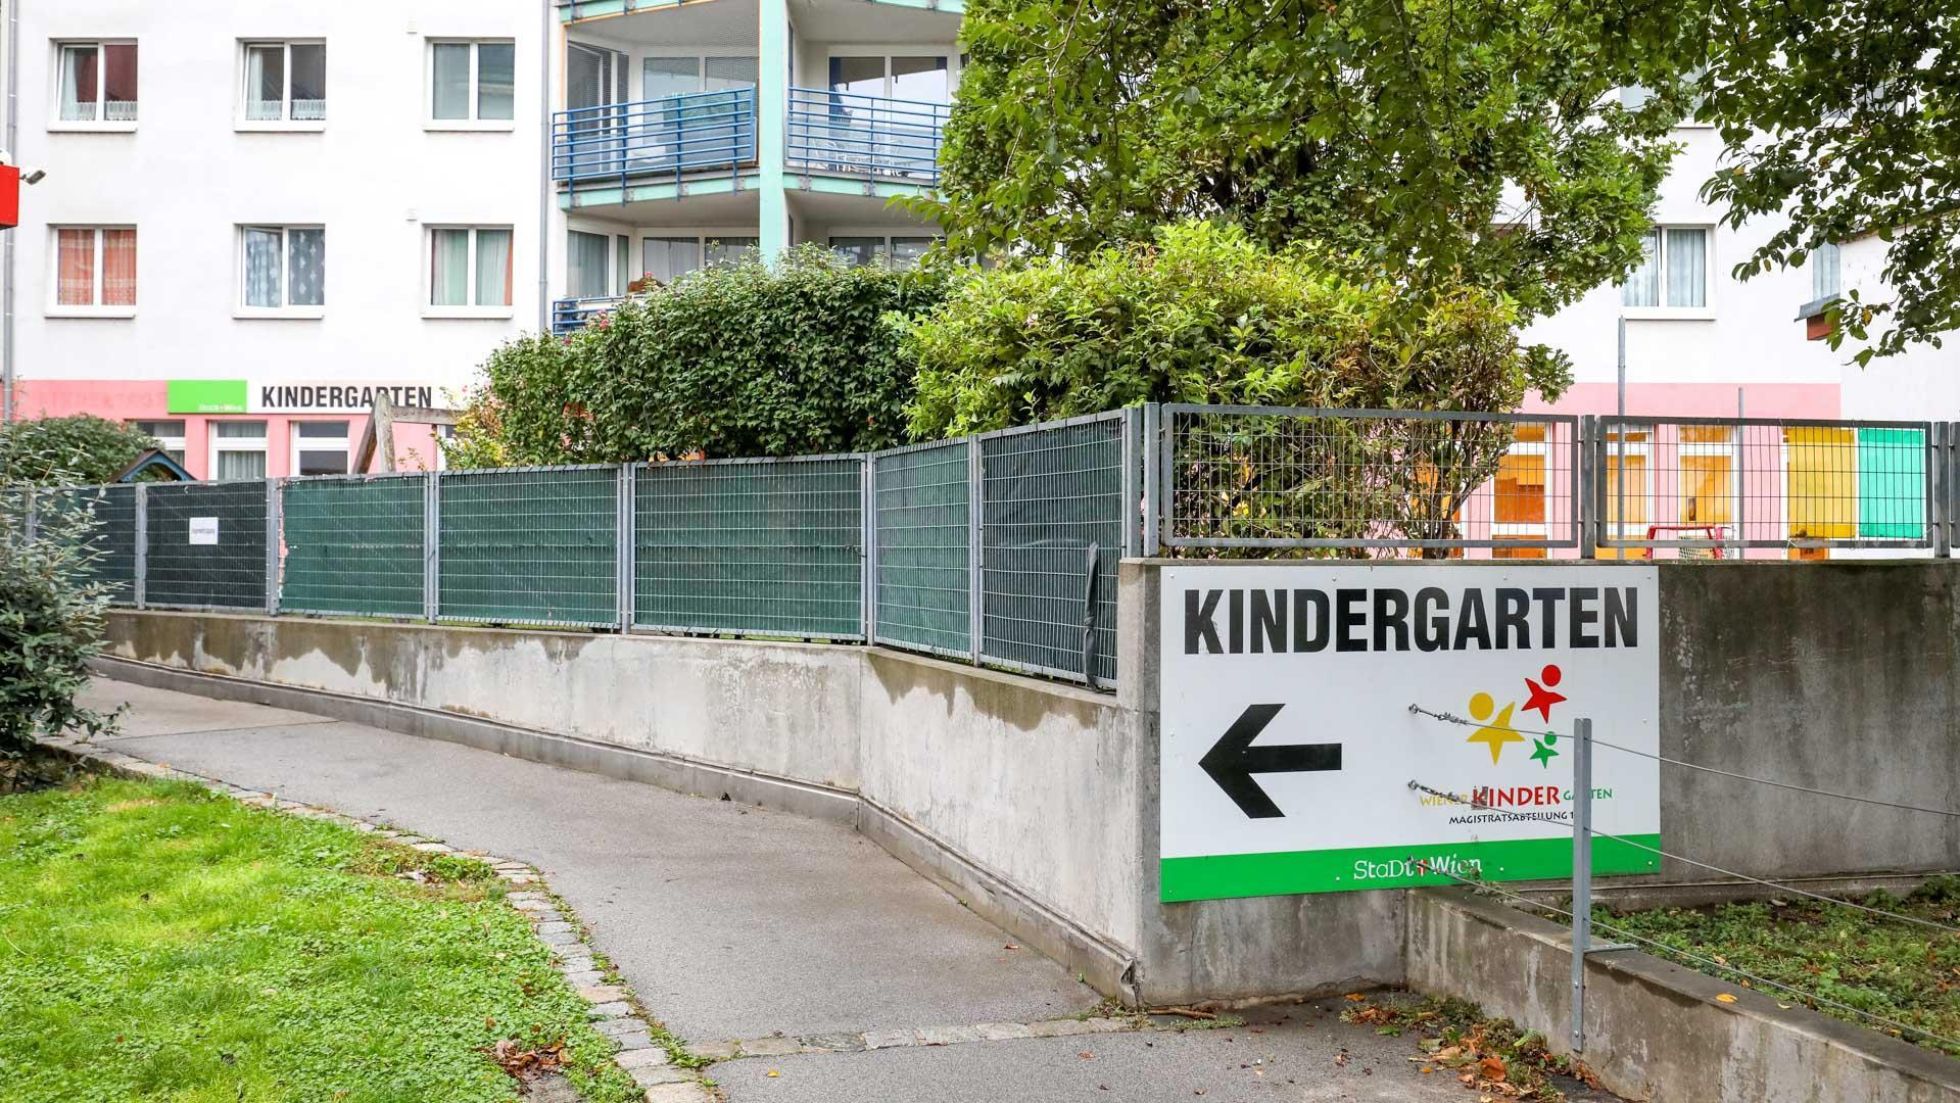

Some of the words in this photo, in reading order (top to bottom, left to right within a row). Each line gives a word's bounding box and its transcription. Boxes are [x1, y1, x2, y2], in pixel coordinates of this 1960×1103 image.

[1184, 586, 1638, 655] KINDERGARTEN
[1419, 793, 1468, 806] WIENR
[1472, 786, 1561, 807] KINDER
[1563, 788, 1613, 801] GTEN
[1448, 811, 1568, 825] MAGISTRATSABTEILUNG
[1430, 853, 1483, 875] Wien
